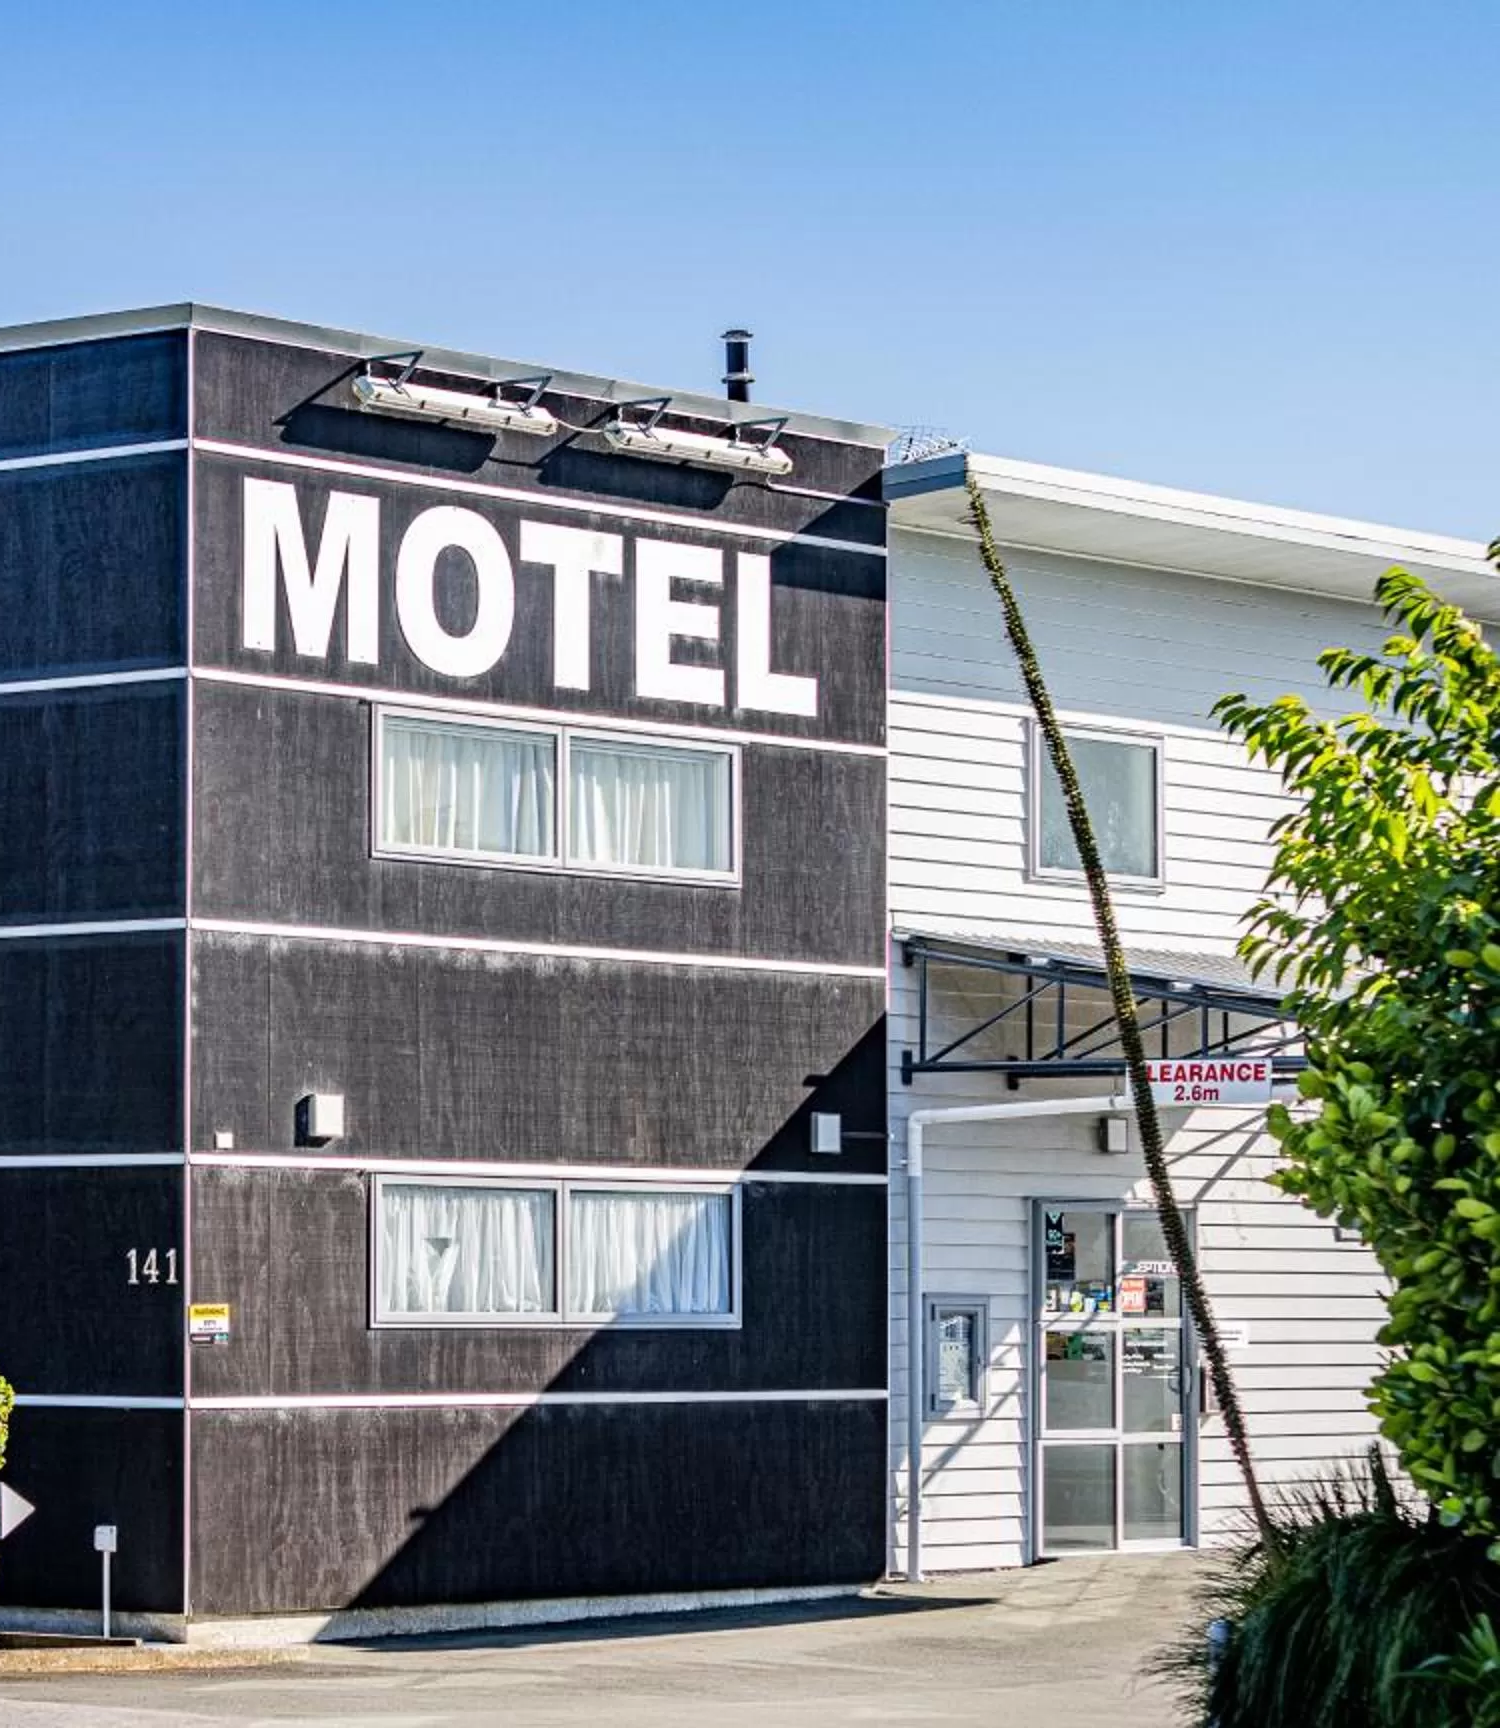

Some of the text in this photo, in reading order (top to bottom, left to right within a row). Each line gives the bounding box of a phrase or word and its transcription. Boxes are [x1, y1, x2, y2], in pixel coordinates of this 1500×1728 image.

[243, 476, 818, 718] MOTEL
[1145, 1063, 1266, 1083] LEARANCE
[1174, 1085, 1220, 1101] 2.6m
[126, 1248, 179, 1285] 141
